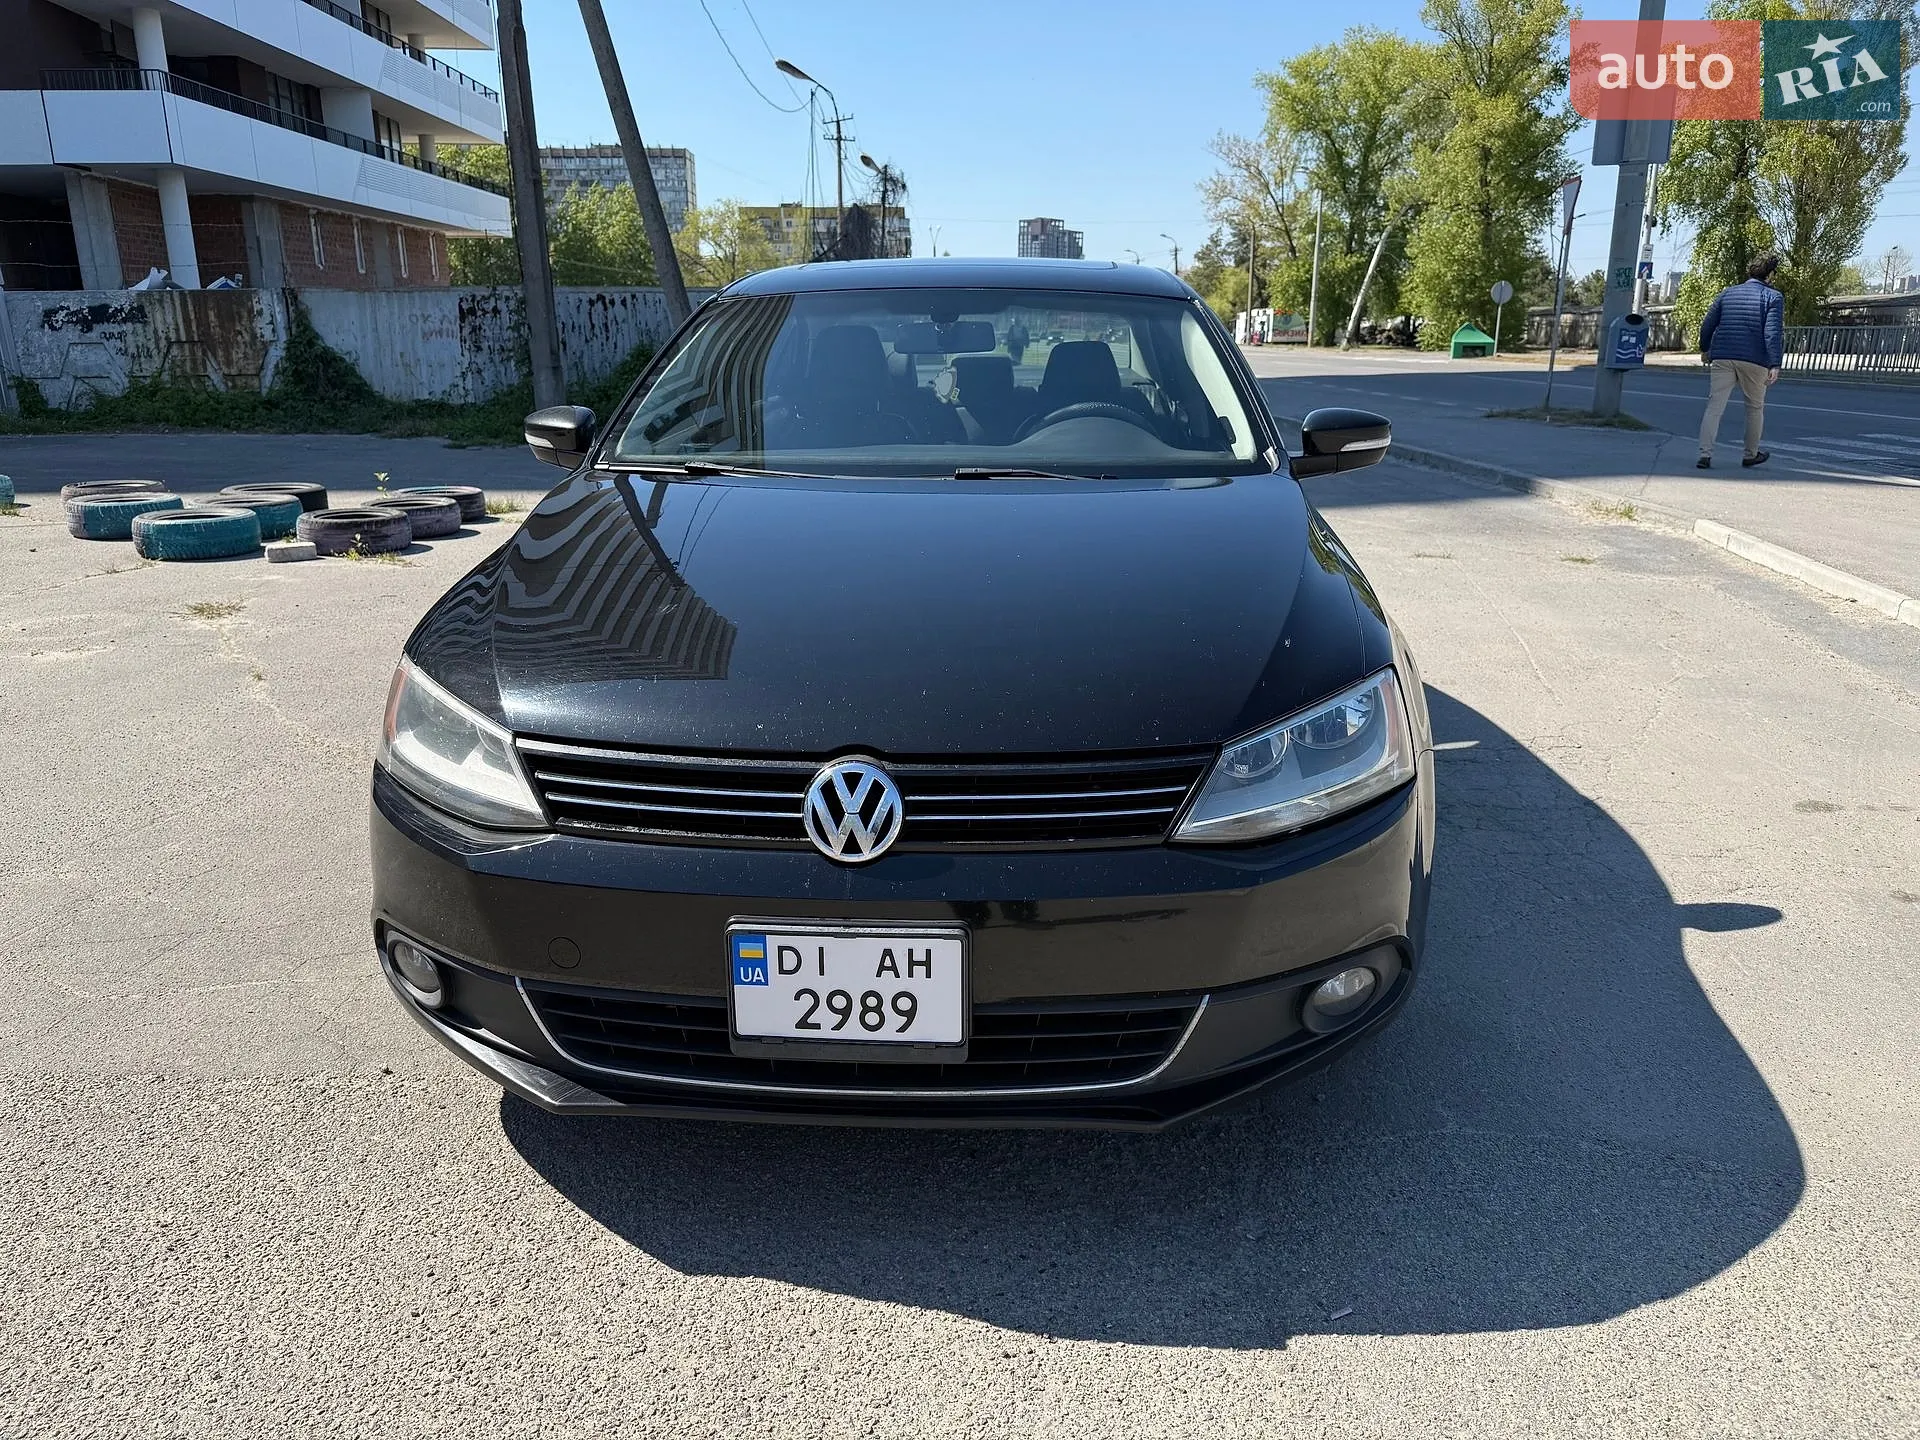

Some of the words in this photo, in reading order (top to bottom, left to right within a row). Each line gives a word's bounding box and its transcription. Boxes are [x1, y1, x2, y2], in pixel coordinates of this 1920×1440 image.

[740, 966, 765, 983] UA
[777, 945, 825, 976] DI
[875, 948, 932, 979] AH
[793, 988, 918, 1033] 2989
